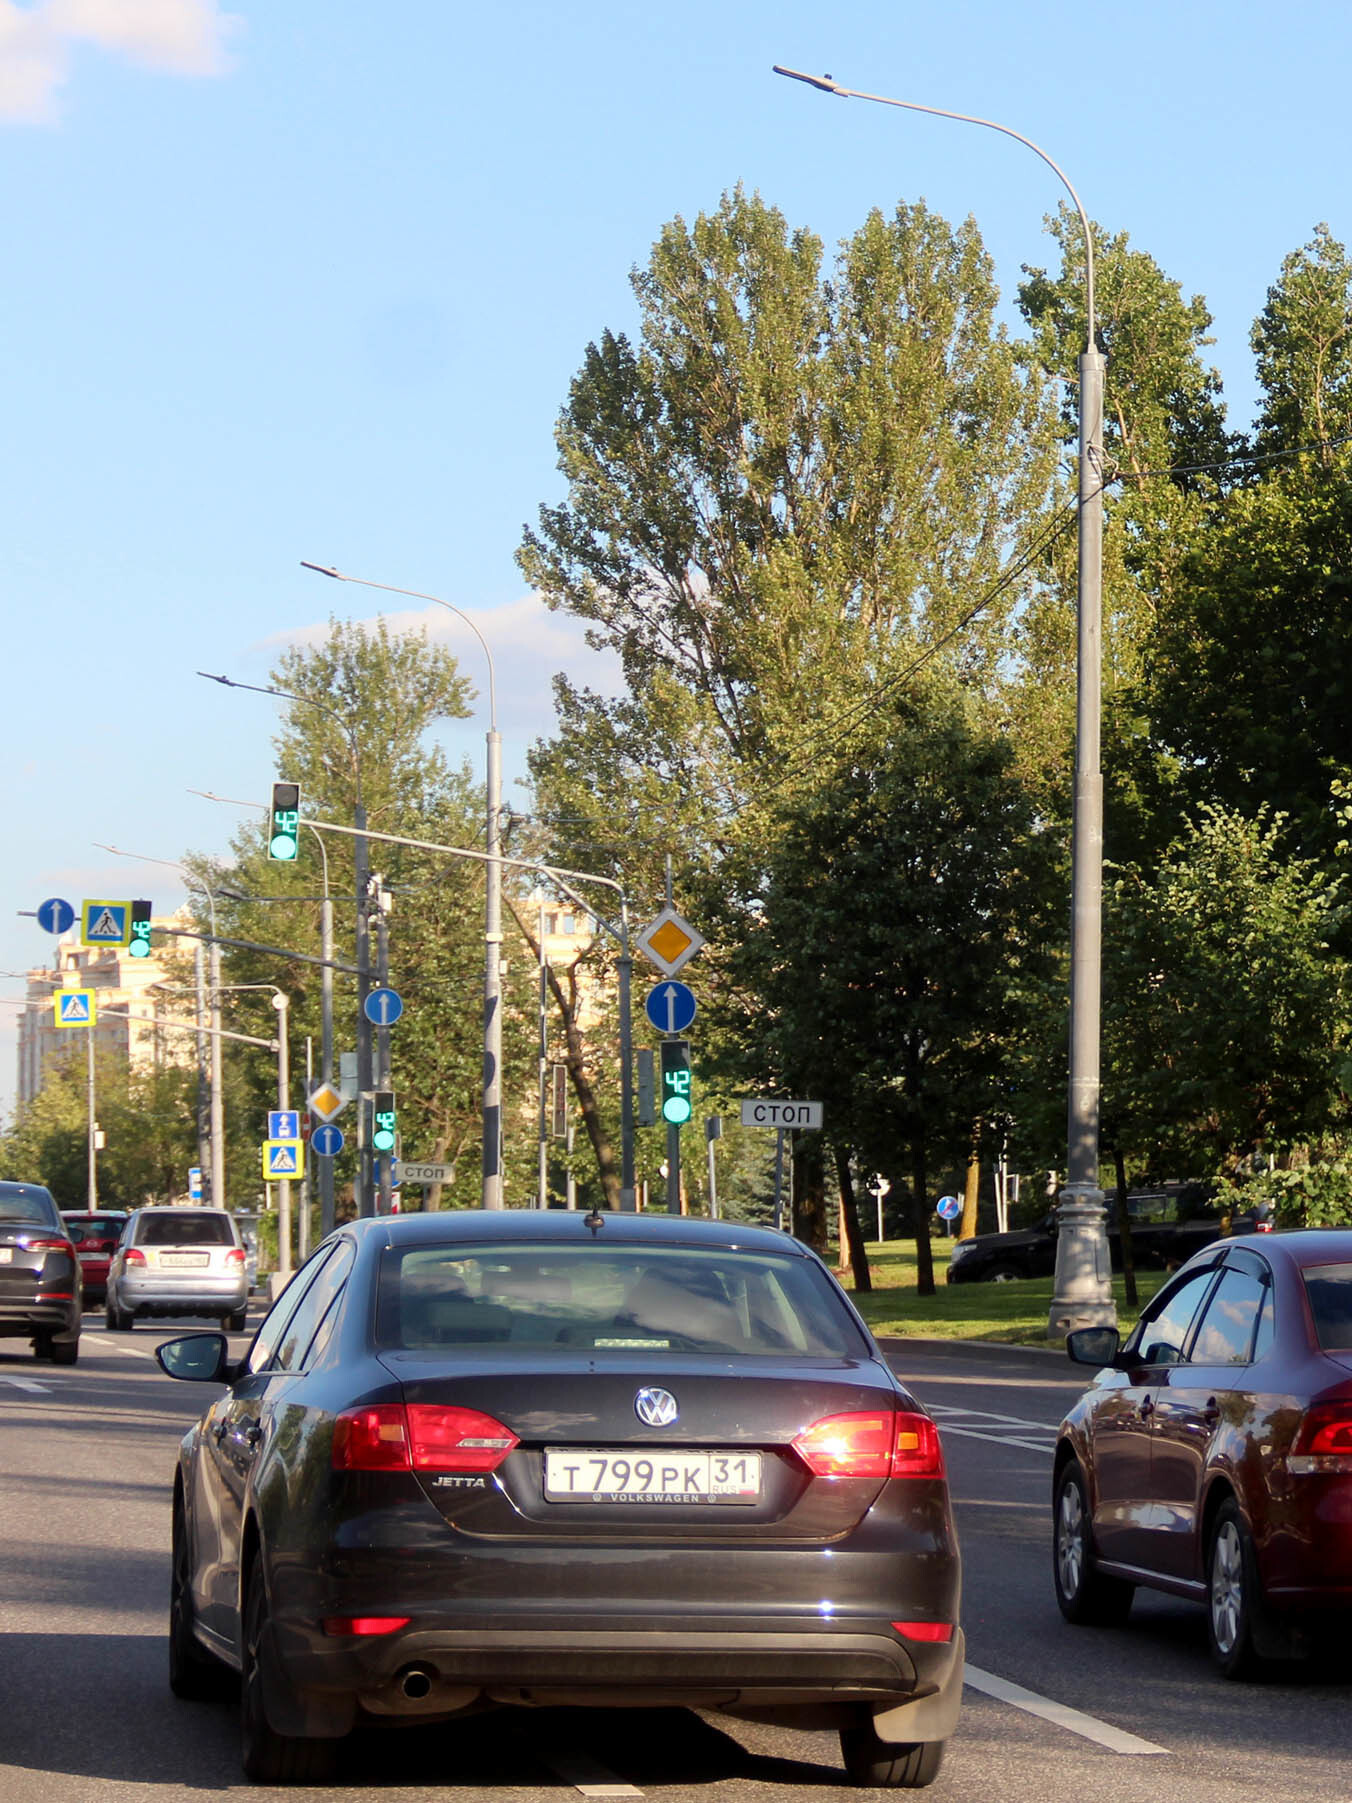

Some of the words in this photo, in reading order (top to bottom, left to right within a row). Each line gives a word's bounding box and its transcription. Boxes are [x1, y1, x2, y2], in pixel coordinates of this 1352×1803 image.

[275, 811, 298, 833] 42
[132, 921, 151, 939] 42
[666, 1070, 690, 1094] 42
[376, 1112, 395, 1129] 42
[753, 1104, 811, 1123] СТОП
[404, 1167, 445, 1179] СТОП
[714, 1458, 747, 1484] 31
[432, 1476, 486, 1489] JETTA
[712, 1485, 738, 1495] RUS
[609, 1493, 700, 1503] VOLKSWAGEN
